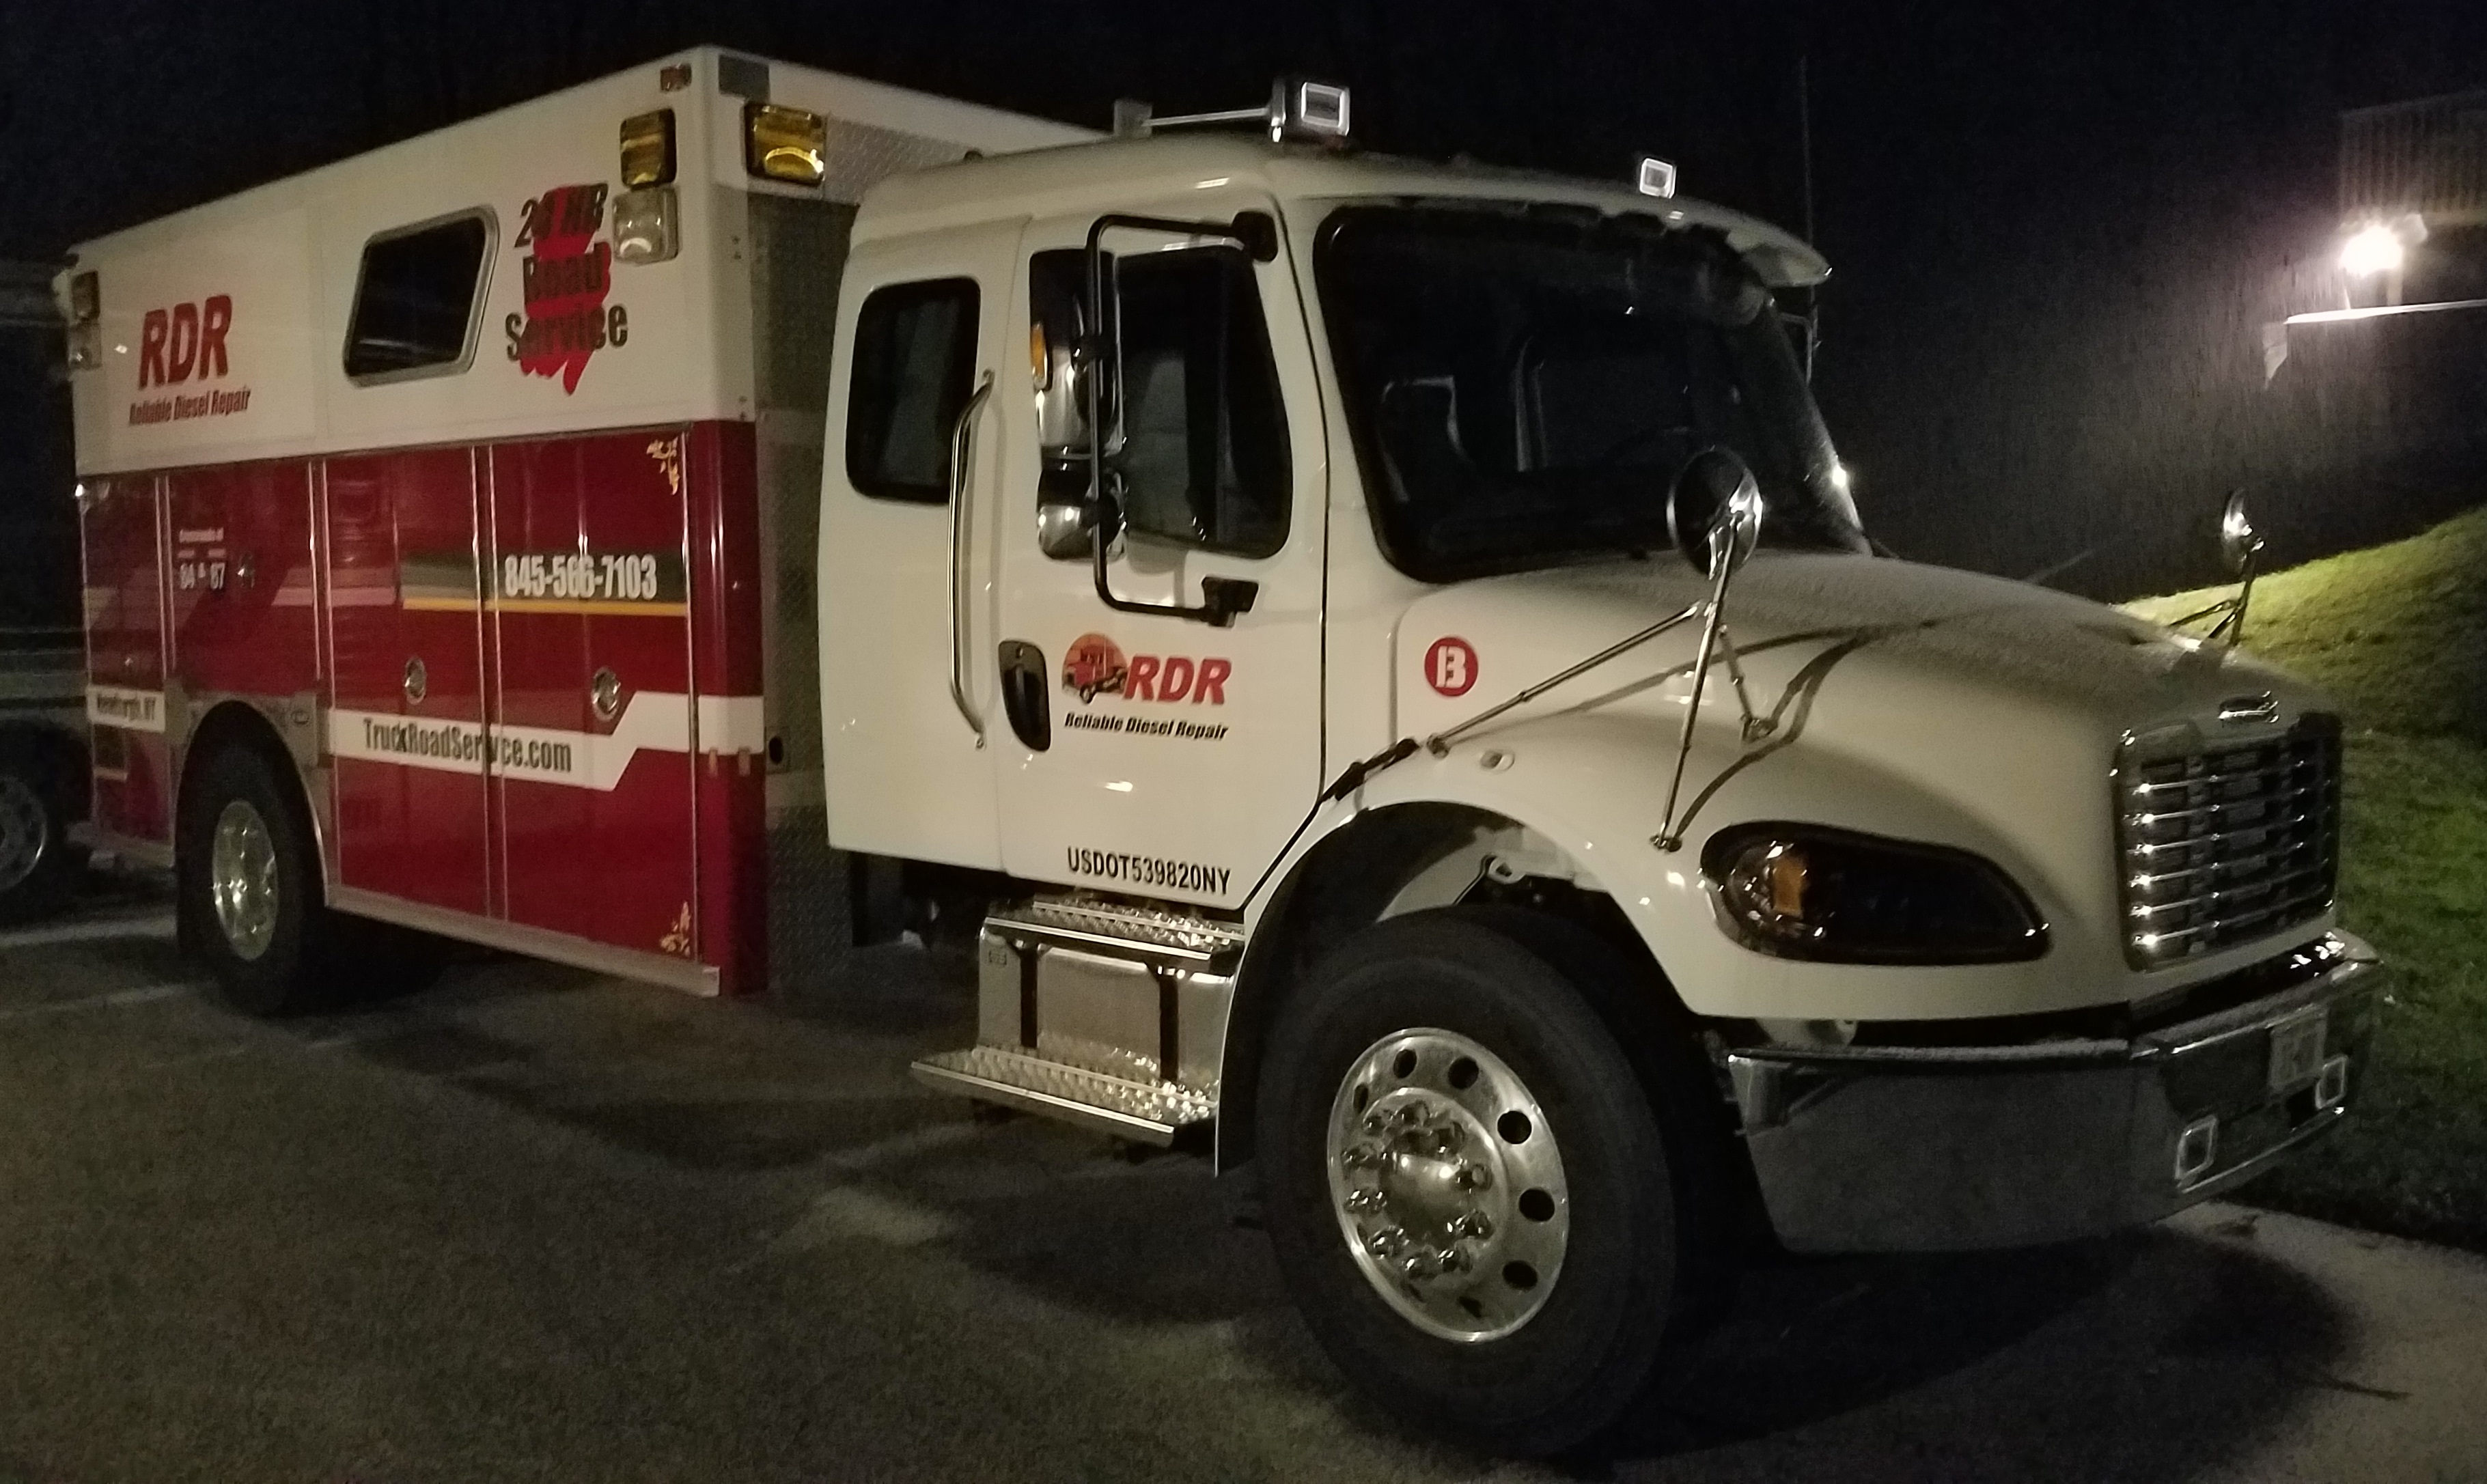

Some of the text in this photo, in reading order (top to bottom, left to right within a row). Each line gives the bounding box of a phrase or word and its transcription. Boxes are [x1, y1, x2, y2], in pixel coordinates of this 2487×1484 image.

[523, 242, 604, 305] Road
[139, 294, 232, 390] RDR
[505, 305, 628, 361] Service
[173, 392, 210, 420] Diesel
[211, 387, 251, 415] Repair
[505, 552, 658, 600] 845-566-7103
[1123, 656, 1232, 705] RDR
[1435, 646, 1466, 688] B
[363, 717, 572, 772] TruckRoadServce.com
[1064, 711, 1228, 741] Reliable Diesel Repair
[1068, 847, 1231, 895] USDOT539820NY
